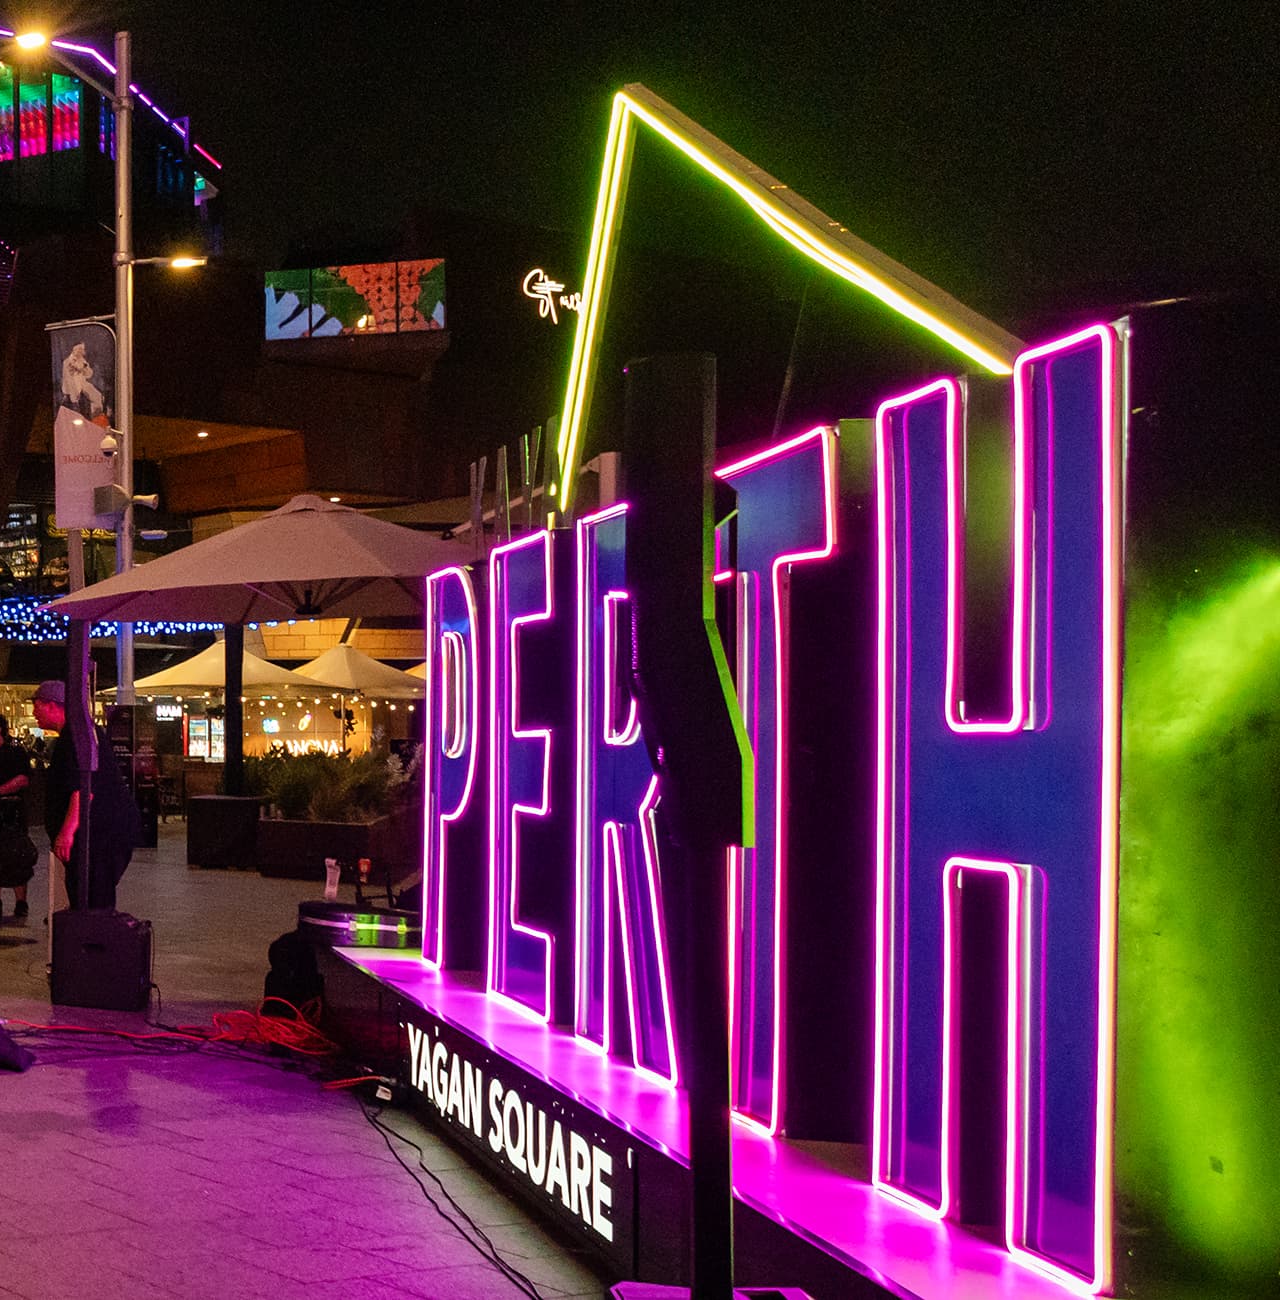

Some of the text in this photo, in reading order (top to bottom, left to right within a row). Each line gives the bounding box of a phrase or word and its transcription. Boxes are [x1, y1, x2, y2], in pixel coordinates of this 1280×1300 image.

[421, 322, 1120, 1297] PERTH
[407, 1022, 614, 1243] YAGAN SQUARE
